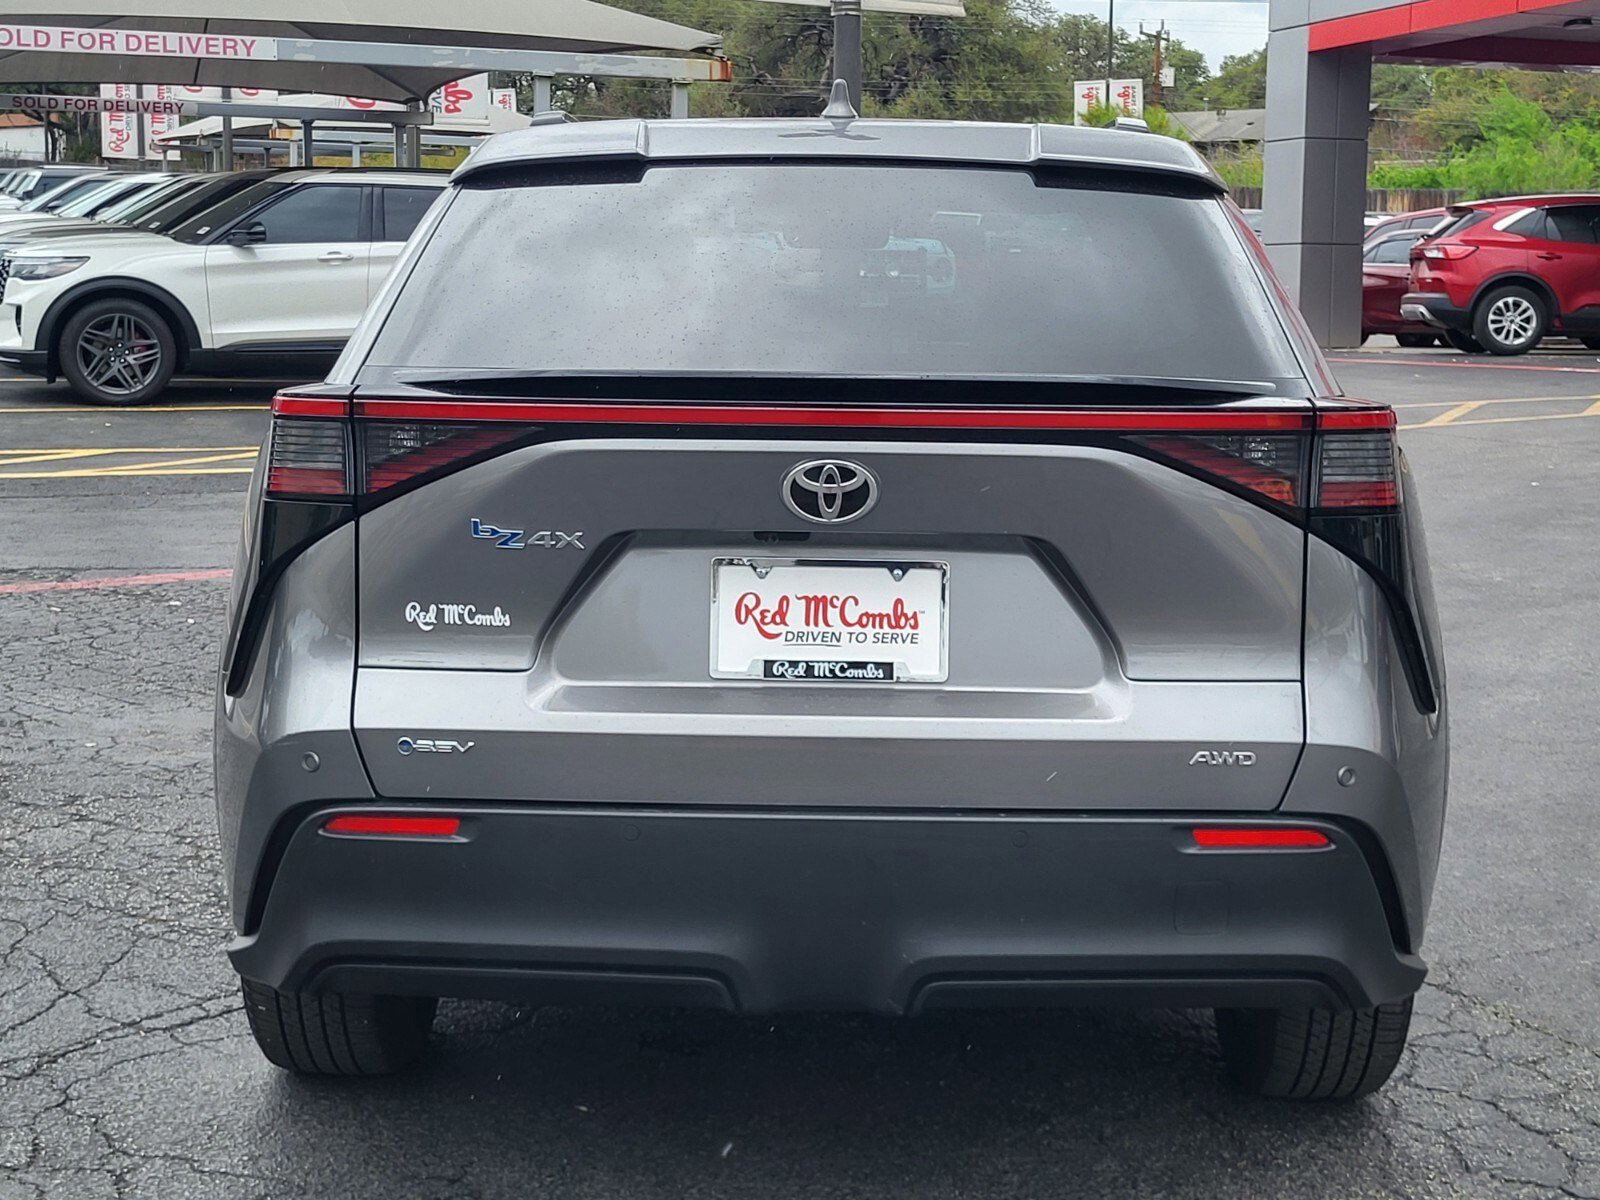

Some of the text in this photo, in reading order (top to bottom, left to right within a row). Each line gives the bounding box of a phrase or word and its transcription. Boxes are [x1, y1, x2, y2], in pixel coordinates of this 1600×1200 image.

[60, 31, 116, 51] FOR
[125, 33, 256, 57] DELIVERY
[12, 95, 184, 114] SOLD FOR DELIVERY
[108, 128, 130, 153] Red
[405, 601, 511, 631] Red McCombs
[734, 591, 919, 640] Red McCombs
[784, 630, 919, 645] DRIVEN TO SERVE
[772, 661, 885, 679] Red McCombs
[1188, 750, 1257, 766] AWD
